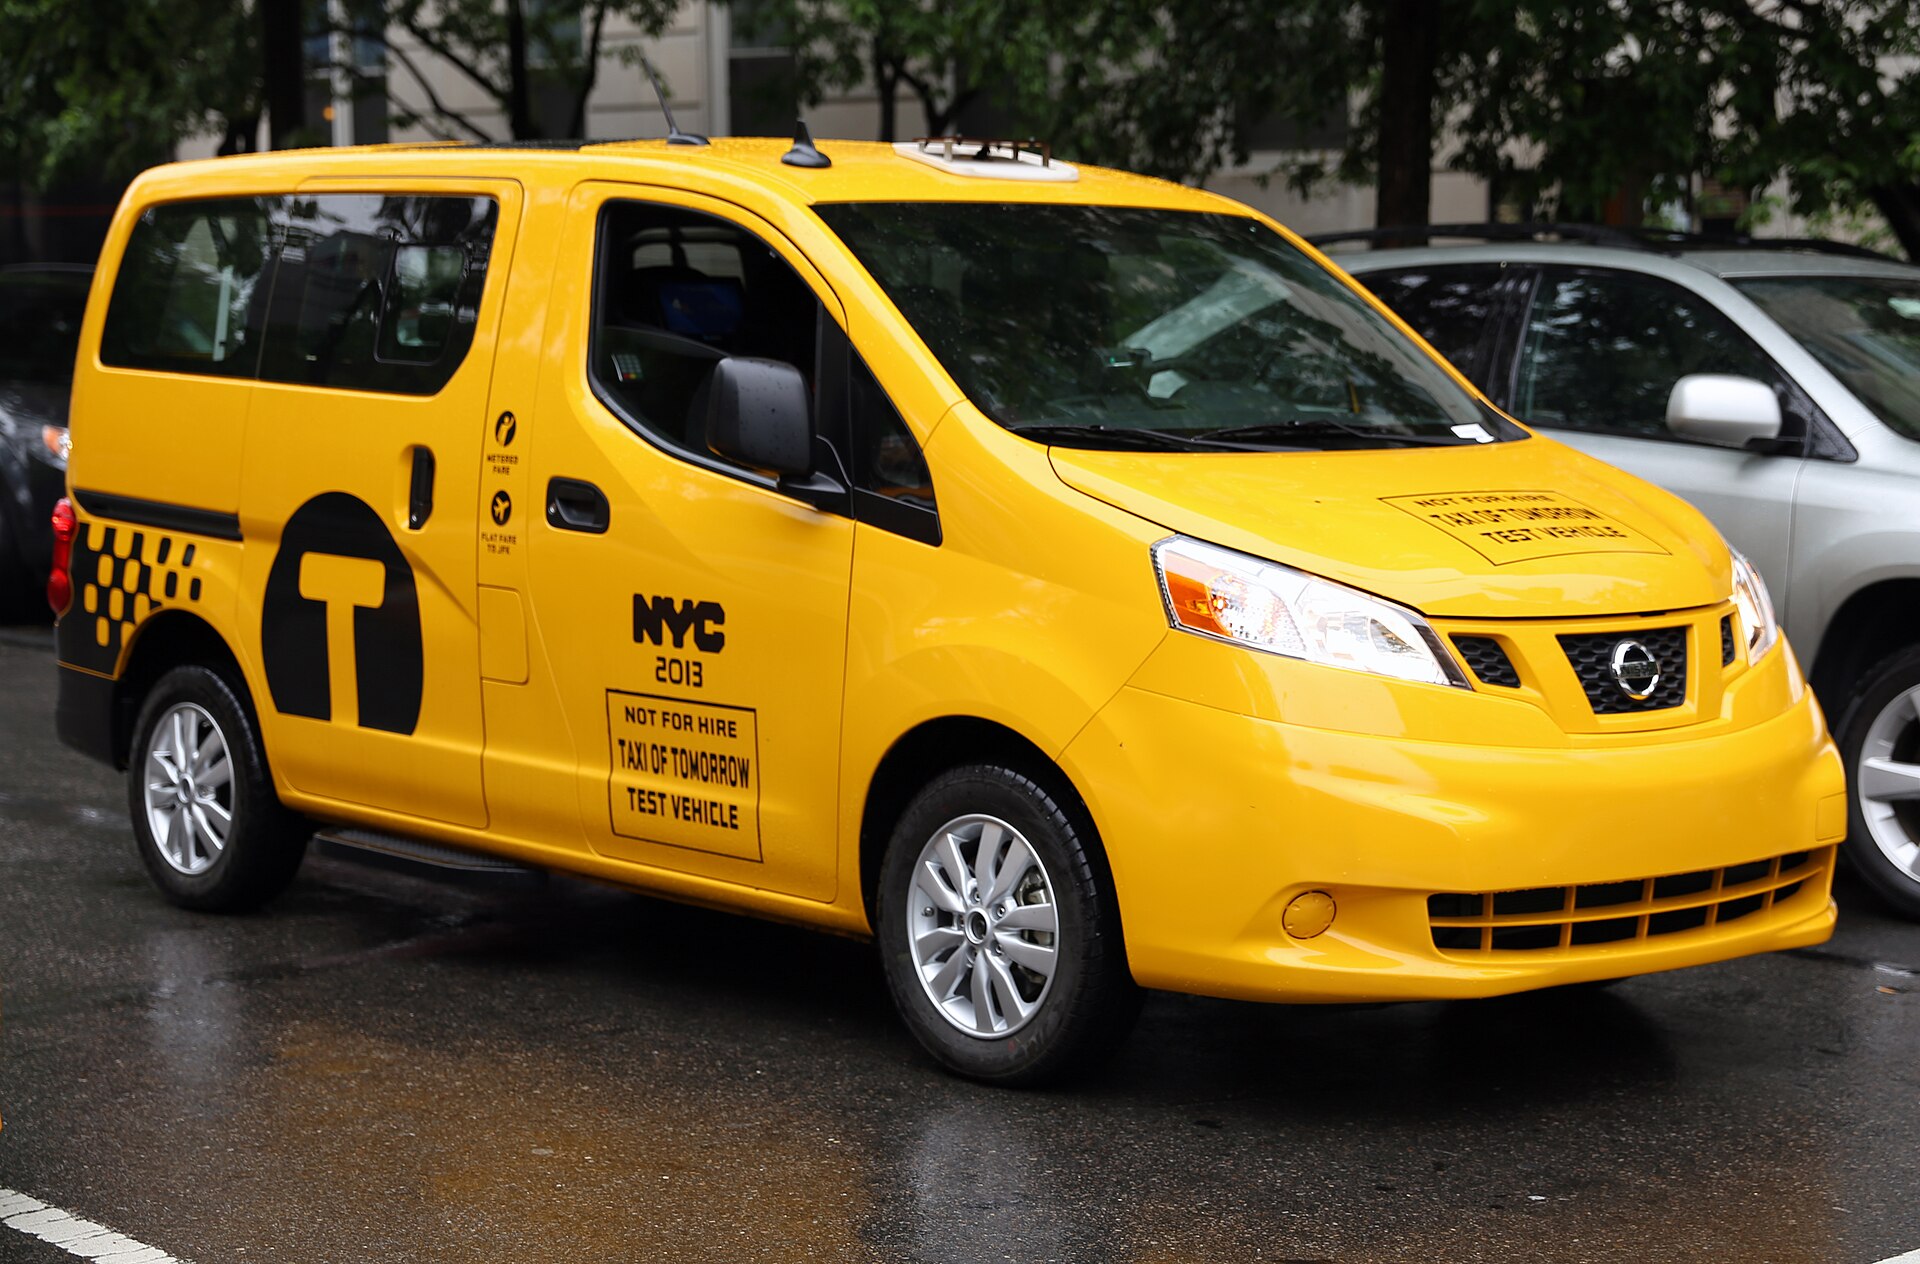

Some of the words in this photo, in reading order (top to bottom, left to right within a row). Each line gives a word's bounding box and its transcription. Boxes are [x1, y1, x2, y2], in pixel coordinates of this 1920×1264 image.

[487, 454, 518, 465] METERED
[493, 465, 510, 475] FARE
[1414, 497, 1459, 507] NOT
[1503, 494, 1556, 502] HIRE
[1430, 511, 1484, 528] TAXI
[1472, 509, 1506, 522] OF
[1497, 507, 1604, 520] TOMORROW
[499, 533, 517, 545] FARE
[1480, 528, 1542, 544] TEST
[1536, 526, 1628, 538] VEHICLE
[633, 593, 725, 654] NYC
[655, 656, 703, 688] 2013
[625, 705, 656, 726] NOT
[662, 711, 693, 732] FOR
[698, 717, 737, 738] HIRE
[618, 739, 648, 772] TAXI
[651, 743, 667, 775] OF
[671, 747, 749, 789] TOMORROW
[627, 787, 667, 817] TEST
[671, 794, 739, 830] VEHICLE
